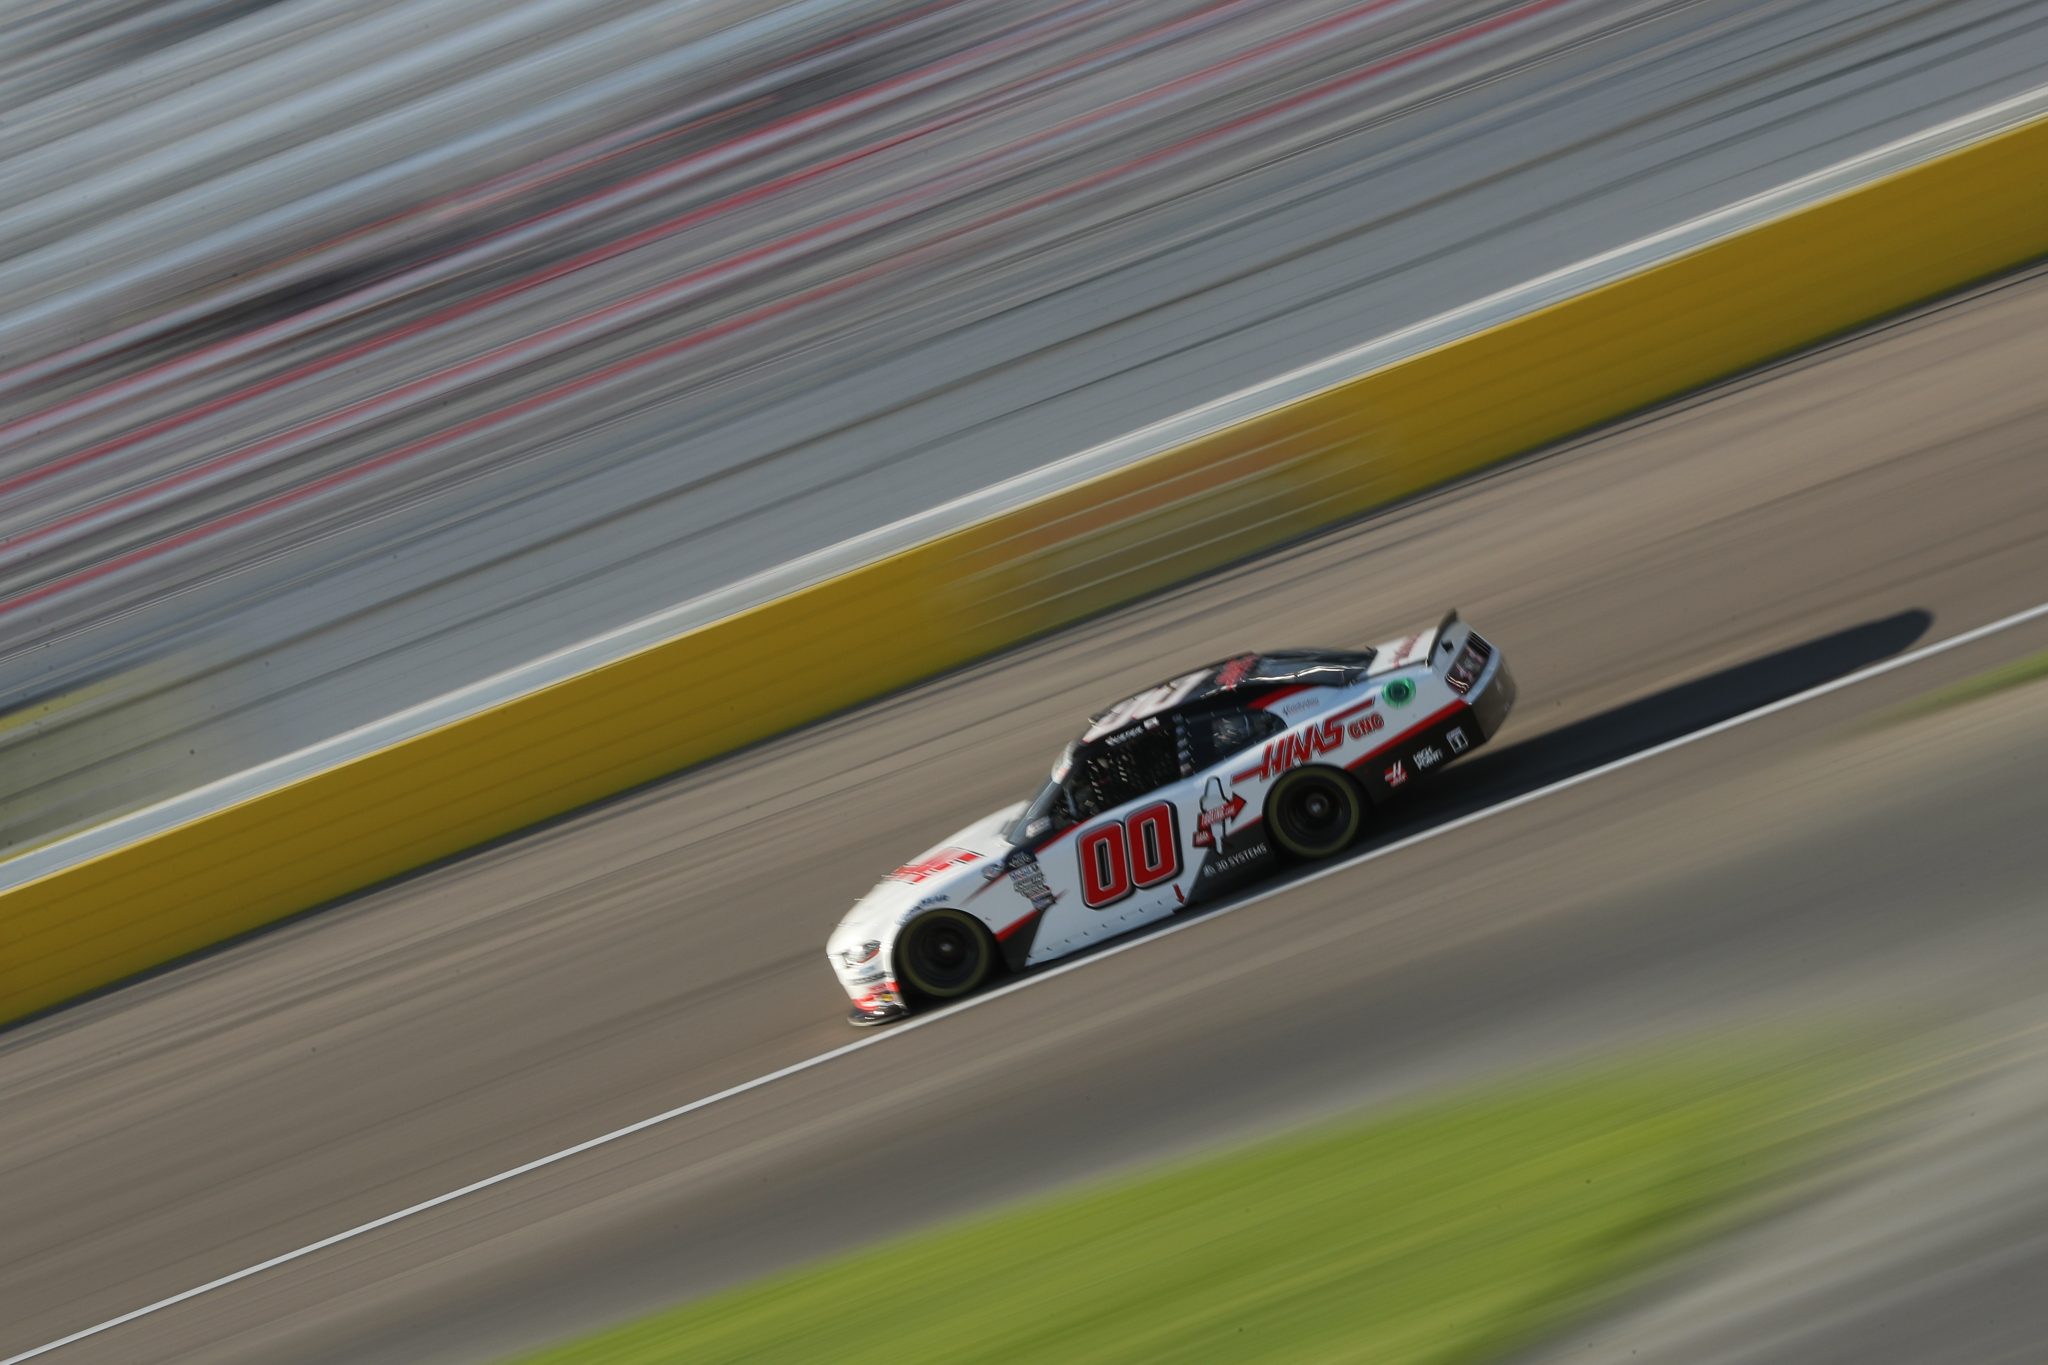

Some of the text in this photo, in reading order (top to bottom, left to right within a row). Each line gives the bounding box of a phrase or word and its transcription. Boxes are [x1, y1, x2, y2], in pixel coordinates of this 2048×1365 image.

[1230, 696, 1376, 786] HAAS
[1075, 799, 1184, 911] 00
[1228, 843, 1267, 865] SYSTEMS
